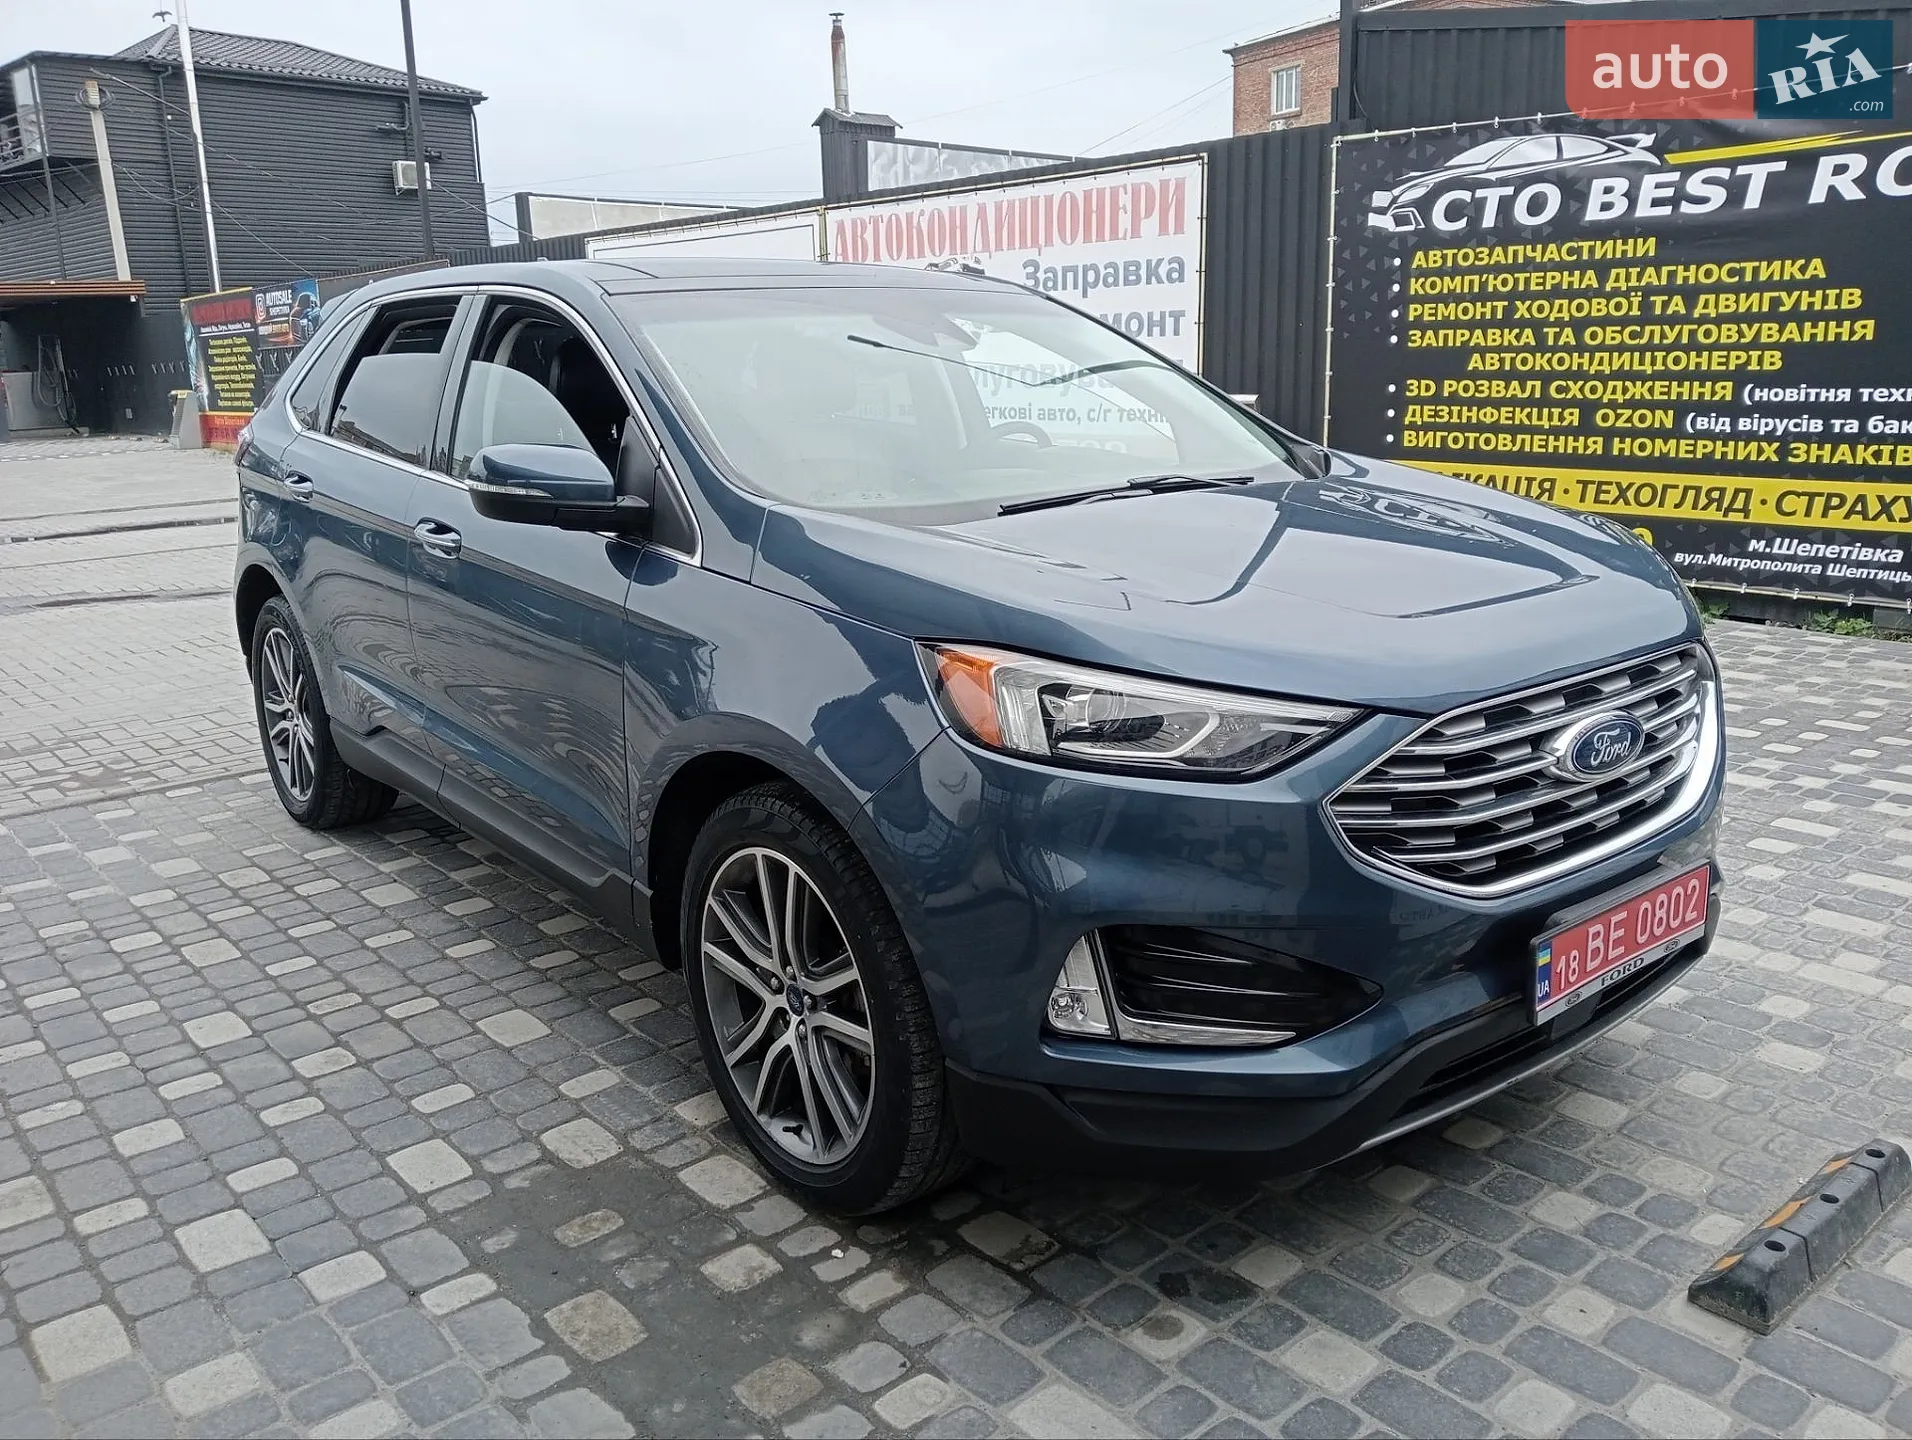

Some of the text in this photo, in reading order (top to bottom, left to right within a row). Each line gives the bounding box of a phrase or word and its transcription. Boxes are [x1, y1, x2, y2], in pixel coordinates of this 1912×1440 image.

[1584, 160, 1788, 222] BEST
[833, 177, 1188, 264] АВТОКОНДИЦІОНЕРИ
[1411, 237, 1657, 269] АВТОЗАПЧАСТИНИ
[1022, 255, 1186, 298] Заправка
[1409, 257, 1828, 295] КОМП'ЮТЕРНА ДІАГНОСТИКА
[1408, 288, 1863, 322] РЕМОНТ ХОДОВОЇ ТА ДВИГУНІВ
[1099, 309, 1186, 338] монт
[1407, 319, 1876, 348] ЗАПРАВКА ТА ОБСЛУГОВУВАННЯ
[1467, 350, 1783, 374] АВТОКОНДИЦІОНЕРІВ
[1405, 379, 1436, 398] 3D
[1443, 379, 1543, 399] РОЗВАЛ
[1549, 380, 1734, 403] СХОДЖЕННЯ
[1743, 384, 1851, 405] (новітня
[1037, 406, 1082, 425] авто,
[1404, 404, 1580, 428] ДЕЗІНФЕКЦІЯ
[1595, 408, 1675, 429] OZON
[1686, 412, 1731, 433] (від
[1738, 413, 1824, 435] вірусів
[1830, 419, 1860, 434] та
[1403, 430, 1912, 467] ВИГОТОВЛЕННЯ НОМЕРНИХ ЗНАКІВ
[1575, 479, 1752, 520] ТЕХОГЛЯД
[1748, 537, 1904, 563] м.Шепетівка
[1674, 552, 1912, 583] вул.Митрополита Шептиць
[1591, 728, 1632, 768] Ford
[1555, 877, 1700, 991] 18 BE 0802
[1600, 957, 1645, 987] FORD
[1537, 982, 1550, 999] UA
